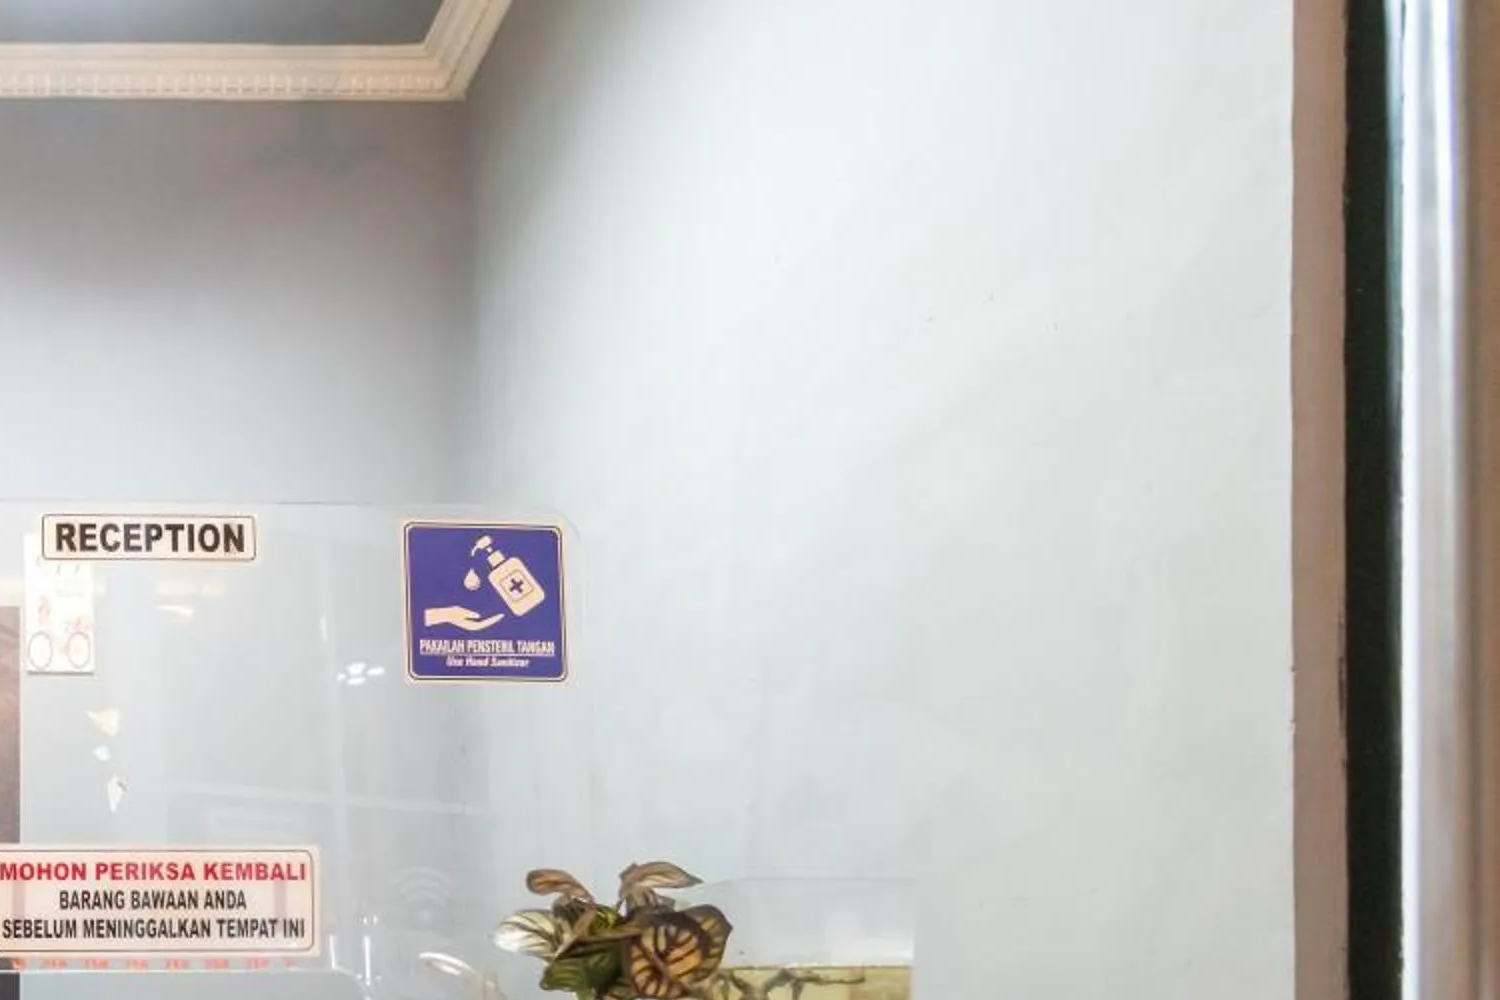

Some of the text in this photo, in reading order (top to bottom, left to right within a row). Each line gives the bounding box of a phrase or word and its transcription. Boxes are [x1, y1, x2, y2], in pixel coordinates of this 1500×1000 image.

[55, 523, 245, 552] RECEPTION
[517, 641, 555, 655] TANGAN
[0, 862, 306, 881] MOHON PERIKSA KEMBALI
[59, 889, 247, 910] BARANG BAWAAN ANDA
[2, 918, 305, 939] SEBELUM MENINGGALKAN TEMPAT INI
